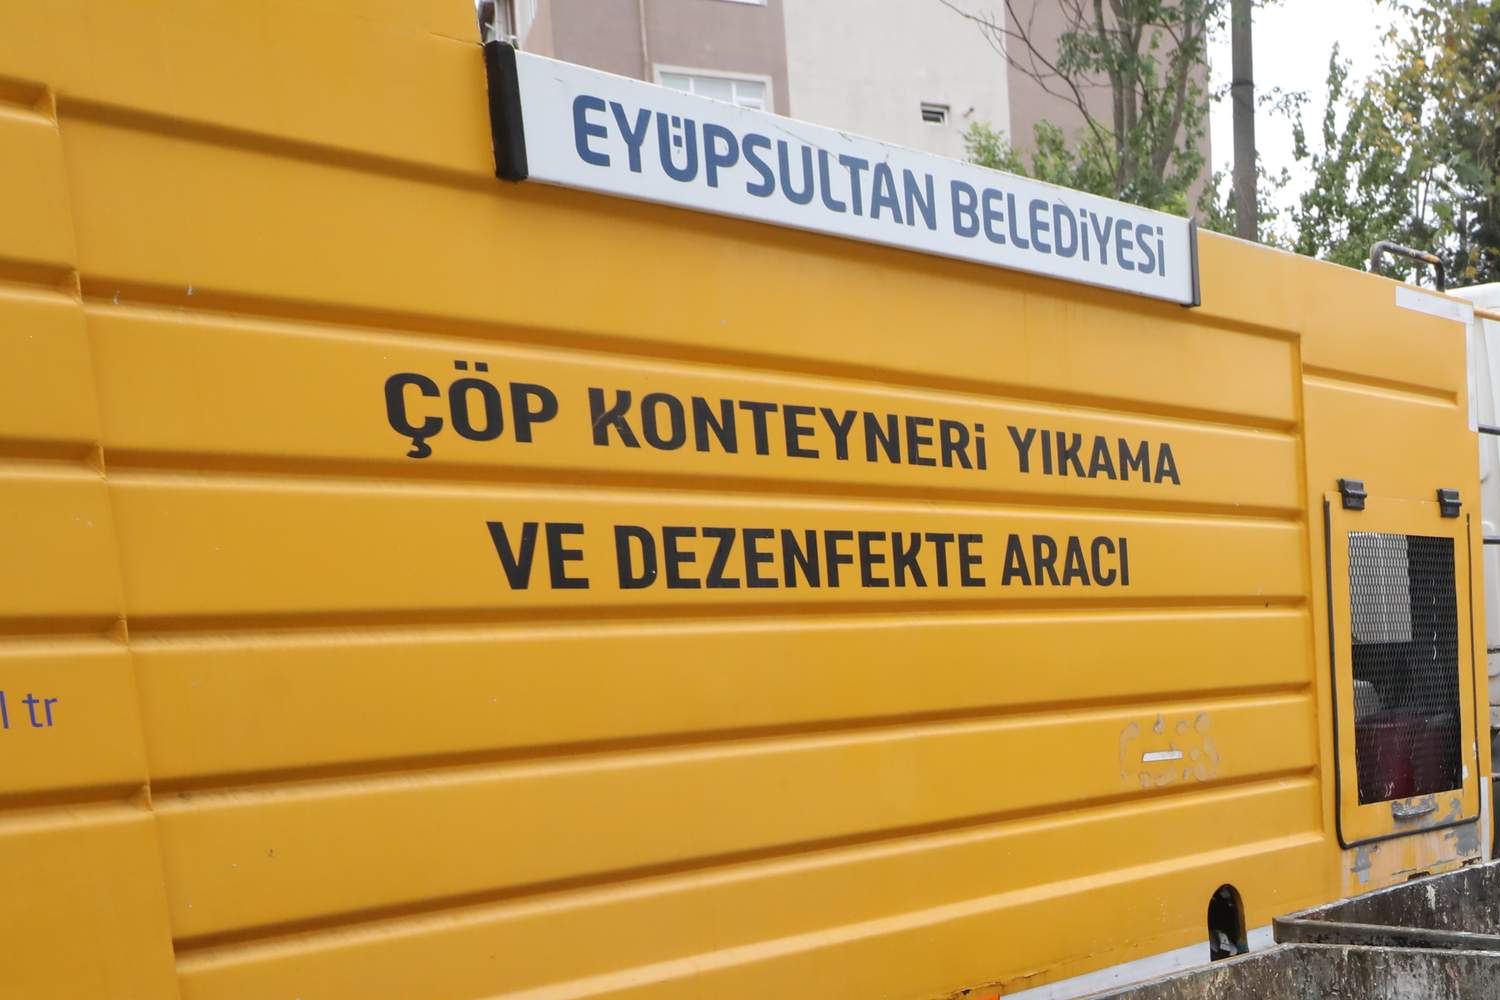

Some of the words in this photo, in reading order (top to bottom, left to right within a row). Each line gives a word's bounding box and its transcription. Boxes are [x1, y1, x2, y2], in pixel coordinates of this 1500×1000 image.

[572, 94, 938, 231] EYÜPSULTAN
[384, 359, 559, 460] ÇÖP
[1007, 425, 1182, 486] YIKAMA
[486, 520, 590, 590] VE
[613, 525, 987, 590] DEZENFEKTE
[1001, 533, 1131, 587] ARACI
